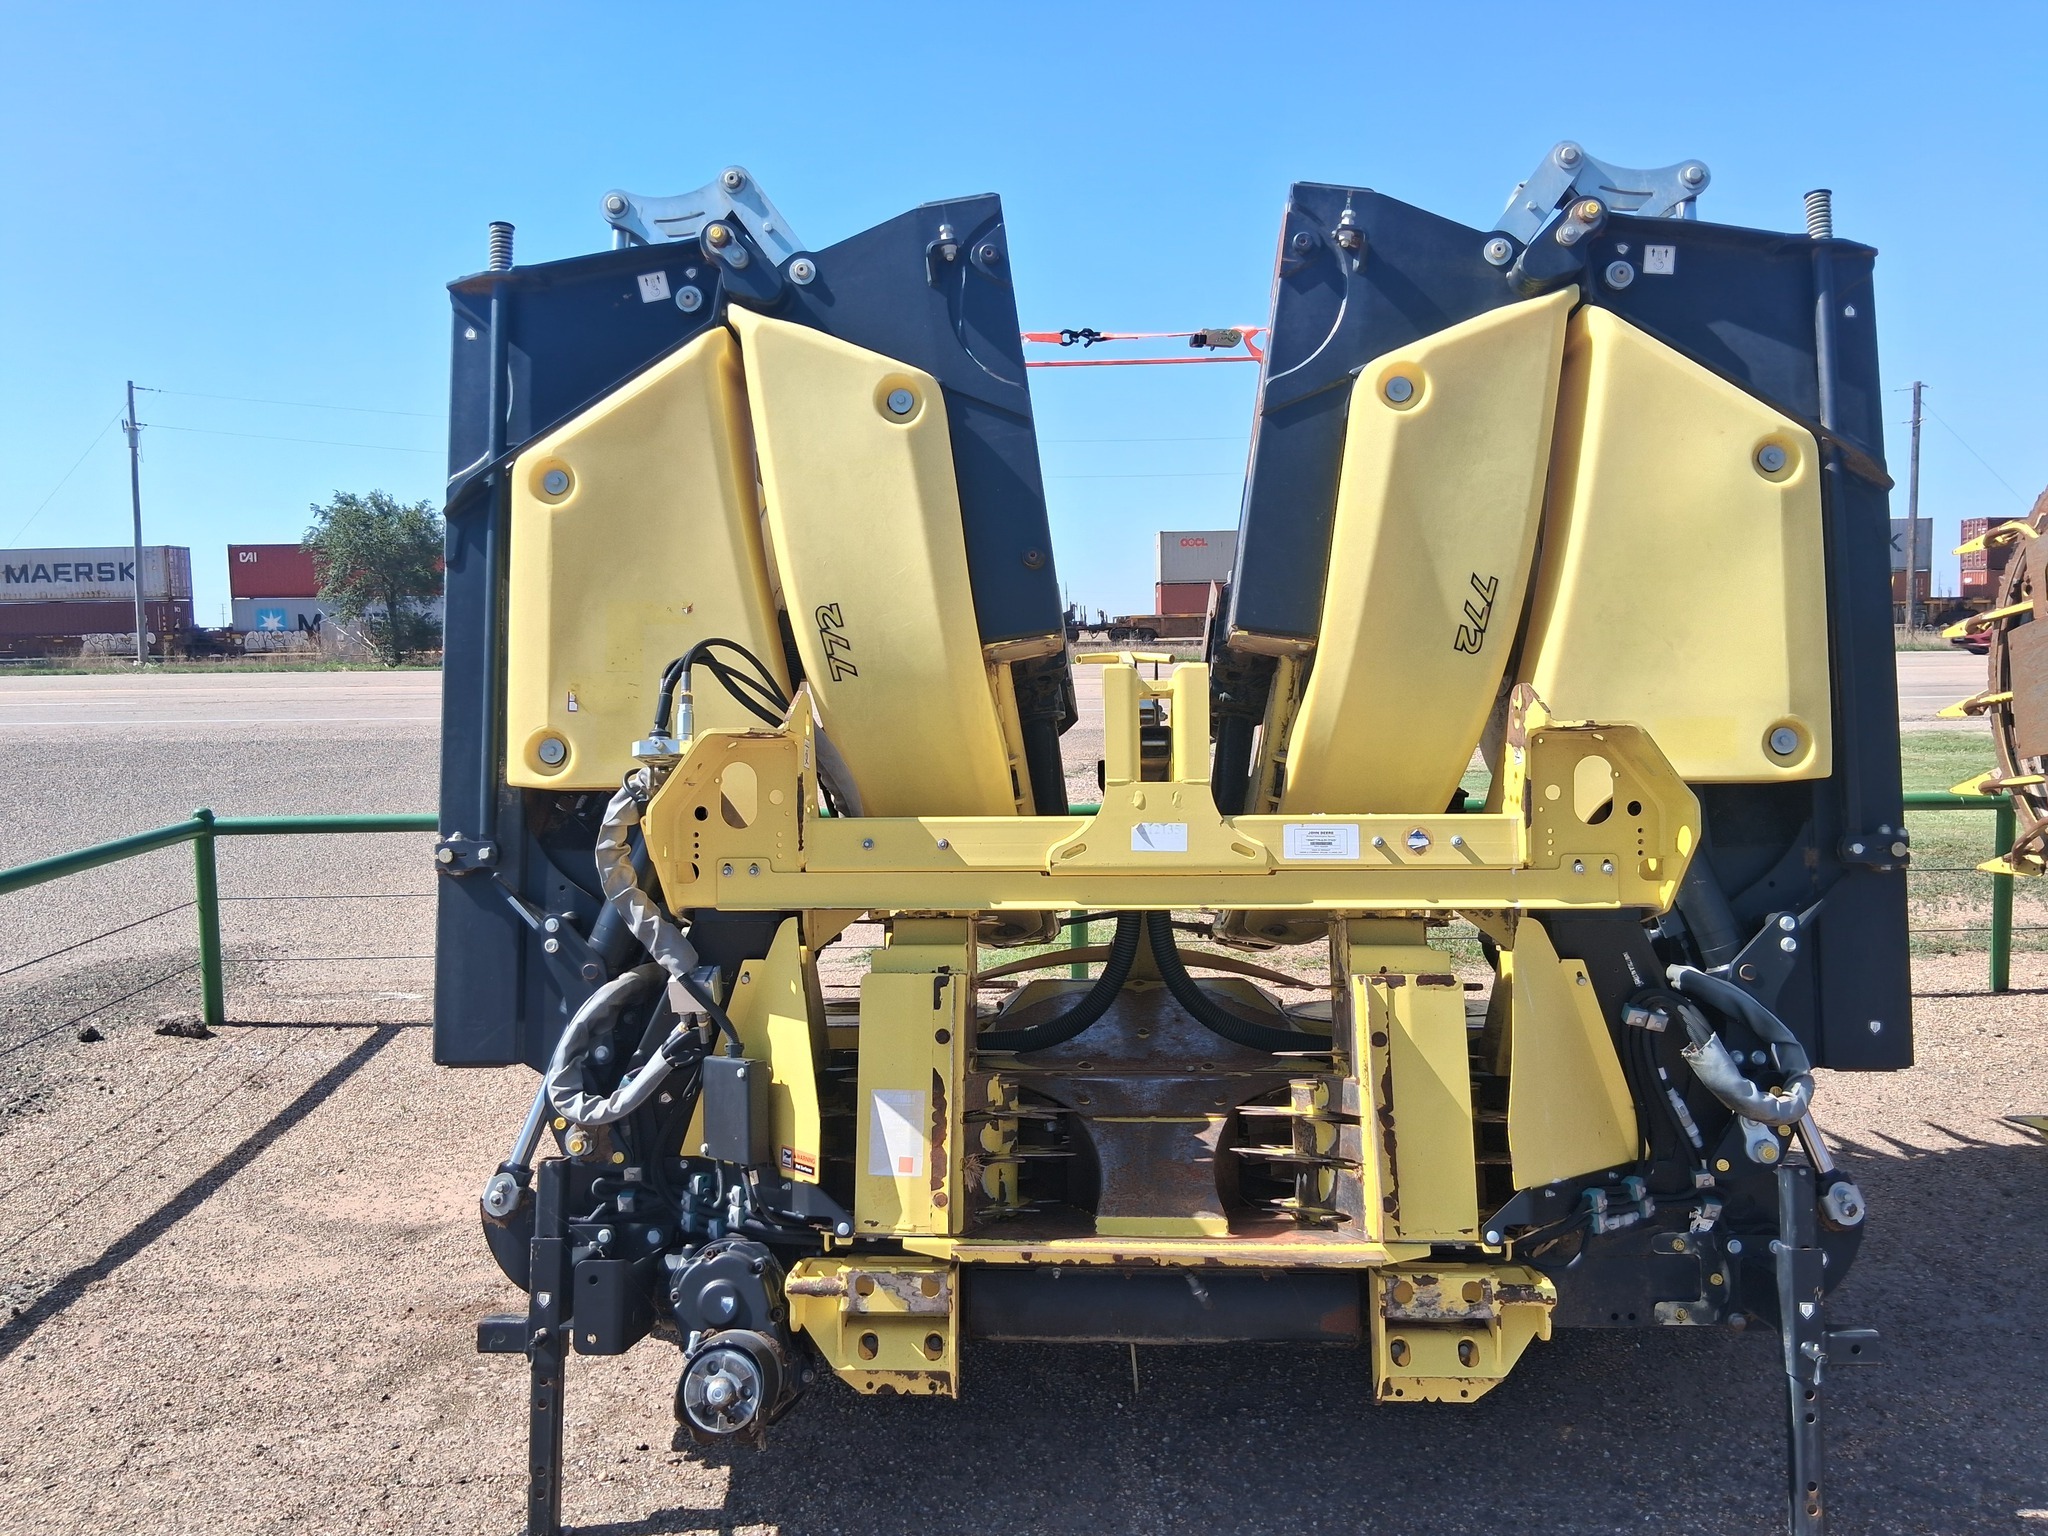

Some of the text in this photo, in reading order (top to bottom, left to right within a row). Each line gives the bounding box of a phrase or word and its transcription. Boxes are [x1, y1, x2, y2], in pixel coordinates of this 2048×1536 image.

[1180, 538, 1208, 547] OOCL
[239, 552, 257, 563] CAI
[5, 562, 135, 584] MAERSK
[1454, 572, 1499, 654] 772
[815, 603, 858, 681] 772
